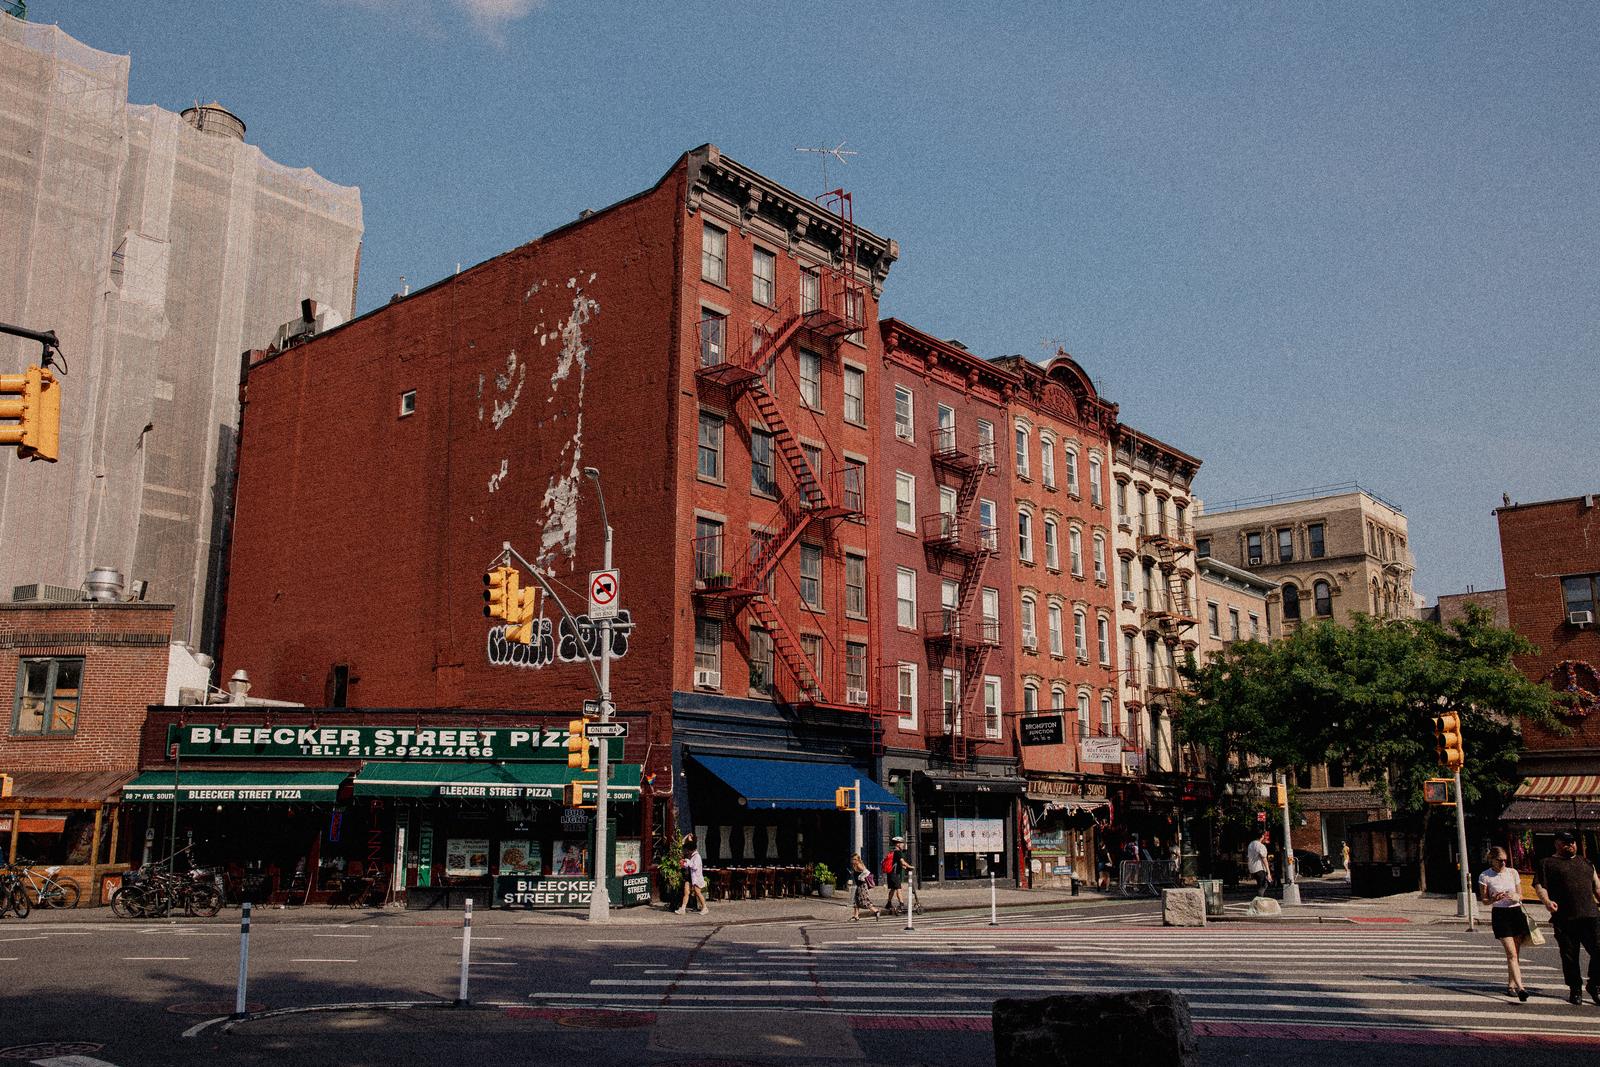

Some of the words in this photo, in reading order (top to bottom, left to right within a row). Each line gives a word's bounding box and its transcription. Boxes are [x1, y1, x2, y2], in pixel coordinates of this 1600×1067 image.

[190, 727, 361, 745] BLEECKER
[374, 729, 497, 747] STREET
[300, 745, 341, 756] TEL:
[348, 745, 494, 757] 212-924-4466
[188, 790, 235, 799] BLEECKER
[238, 790, 274, 799] STREET
[275, 790, 302, 799] PIZZA
[440, 786, 486, 796] BLEECKER
[489, 787, 523, 797] STREET
[526, 787, 552, 797] PIZZA
[564, 808, 585, 817] BUD
[560, 816, 589, 824] LIGHT
[517, 881, 597, 892] BLEECKER
[623, 876, 649, 887] BLEECKER
[627, 884, 647, 894] STREET
[504, 892, 565, 904] STREET
[636, 892, 651, 901] PIZZA
